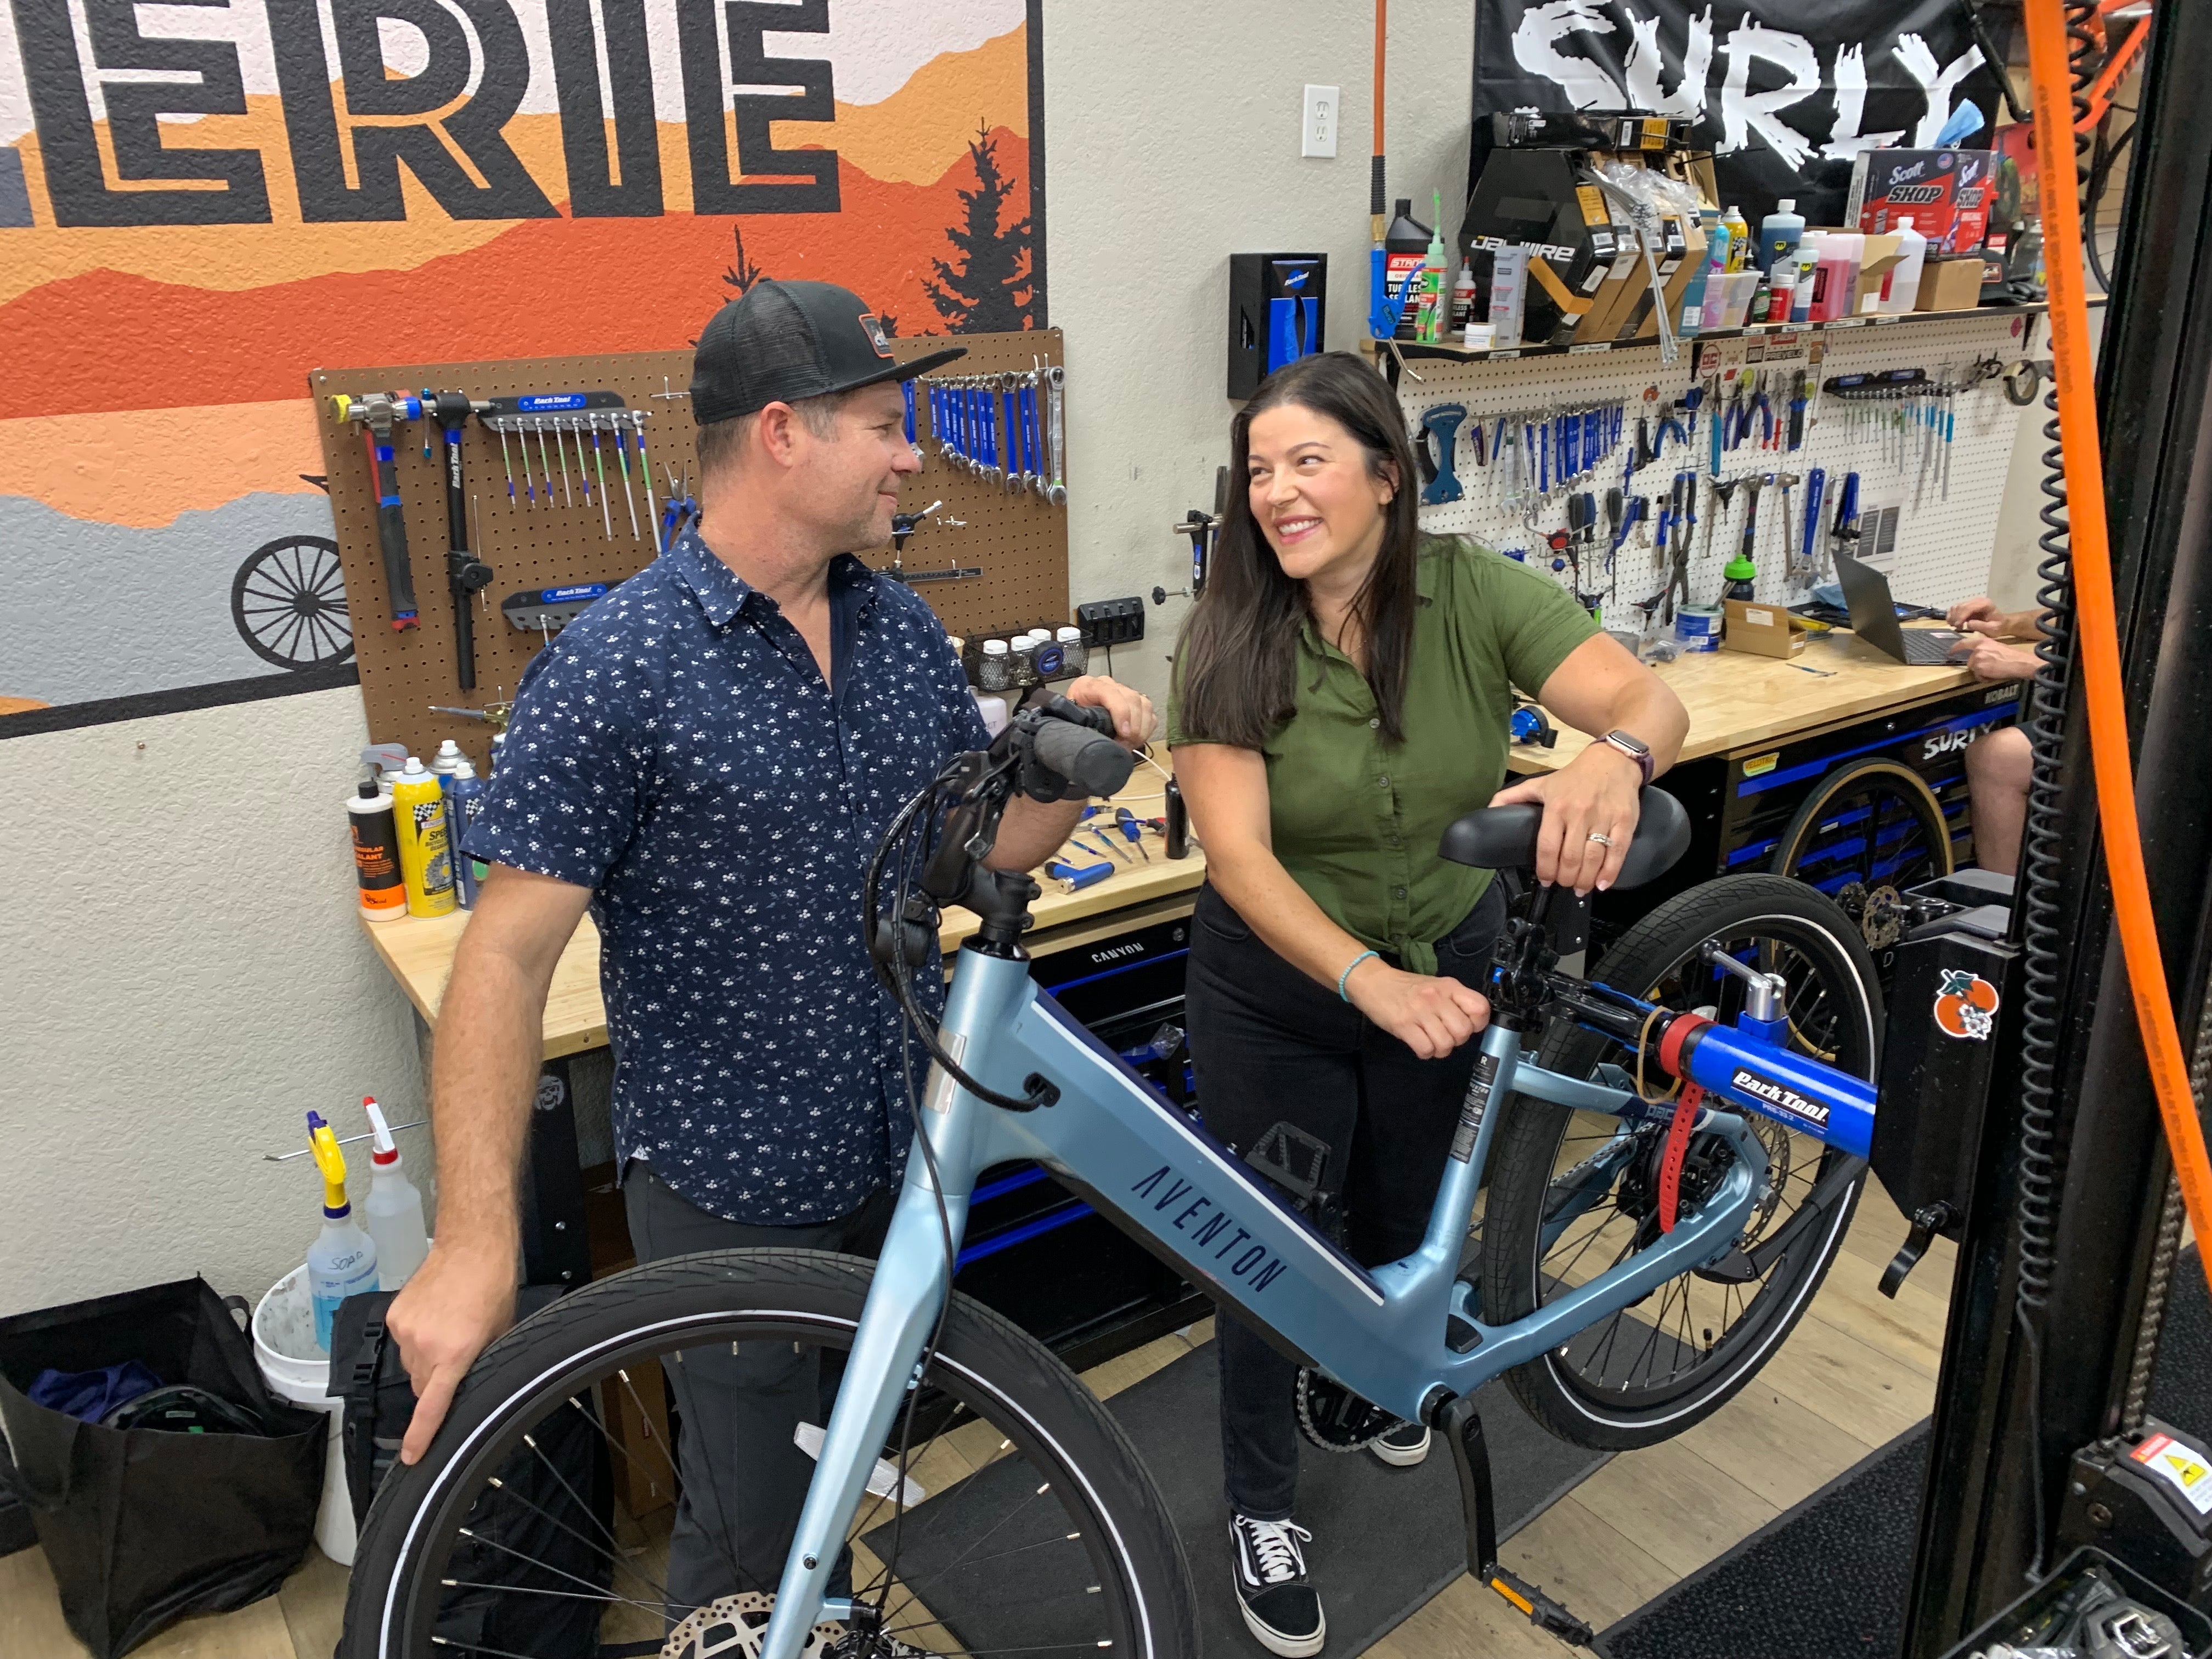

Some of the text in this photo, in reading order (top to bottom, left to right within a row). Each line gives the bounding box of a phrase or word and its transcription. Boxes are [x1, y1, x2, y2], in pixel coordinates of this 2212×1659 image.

[1512, 0, 1986, 172] SURLY
[1889, 161, 1924, 185] Scott
[1887, 186, 1944, 204] SHOP
[1956, 188, 1984, 208] SHOP
[1765, 349, 1803, 360] PREVELO
[1984, 684, 2019, 704] KOBALT
[1091, 942, 1144, 964] CANYON
[1131, 1165, 1287, 1293] AVENTON
